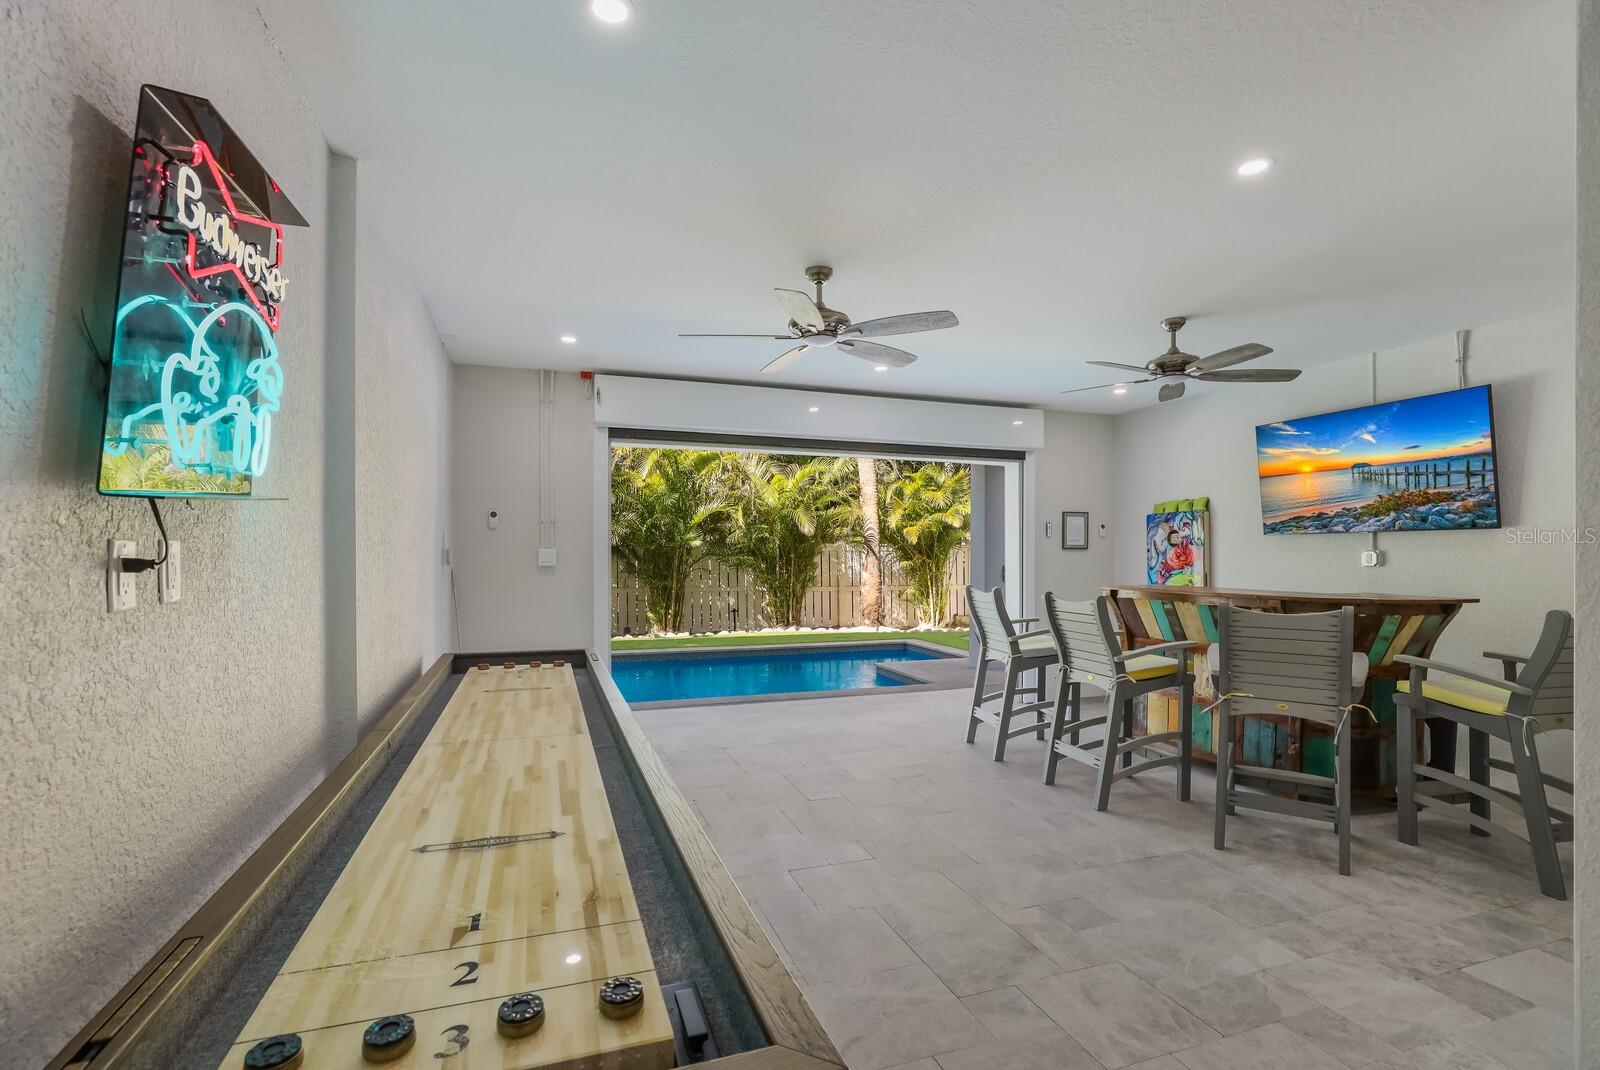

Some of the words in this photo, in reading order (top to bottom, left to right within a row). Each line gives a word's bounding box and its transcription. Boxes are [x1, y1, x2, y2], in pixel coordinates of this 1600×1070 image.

[177, 165, 289, 302] Budweiser
[466, 912, 484, 932] 1
[449, 961, 479, 988] 2
[433, 1024, 470, 1060] 3
